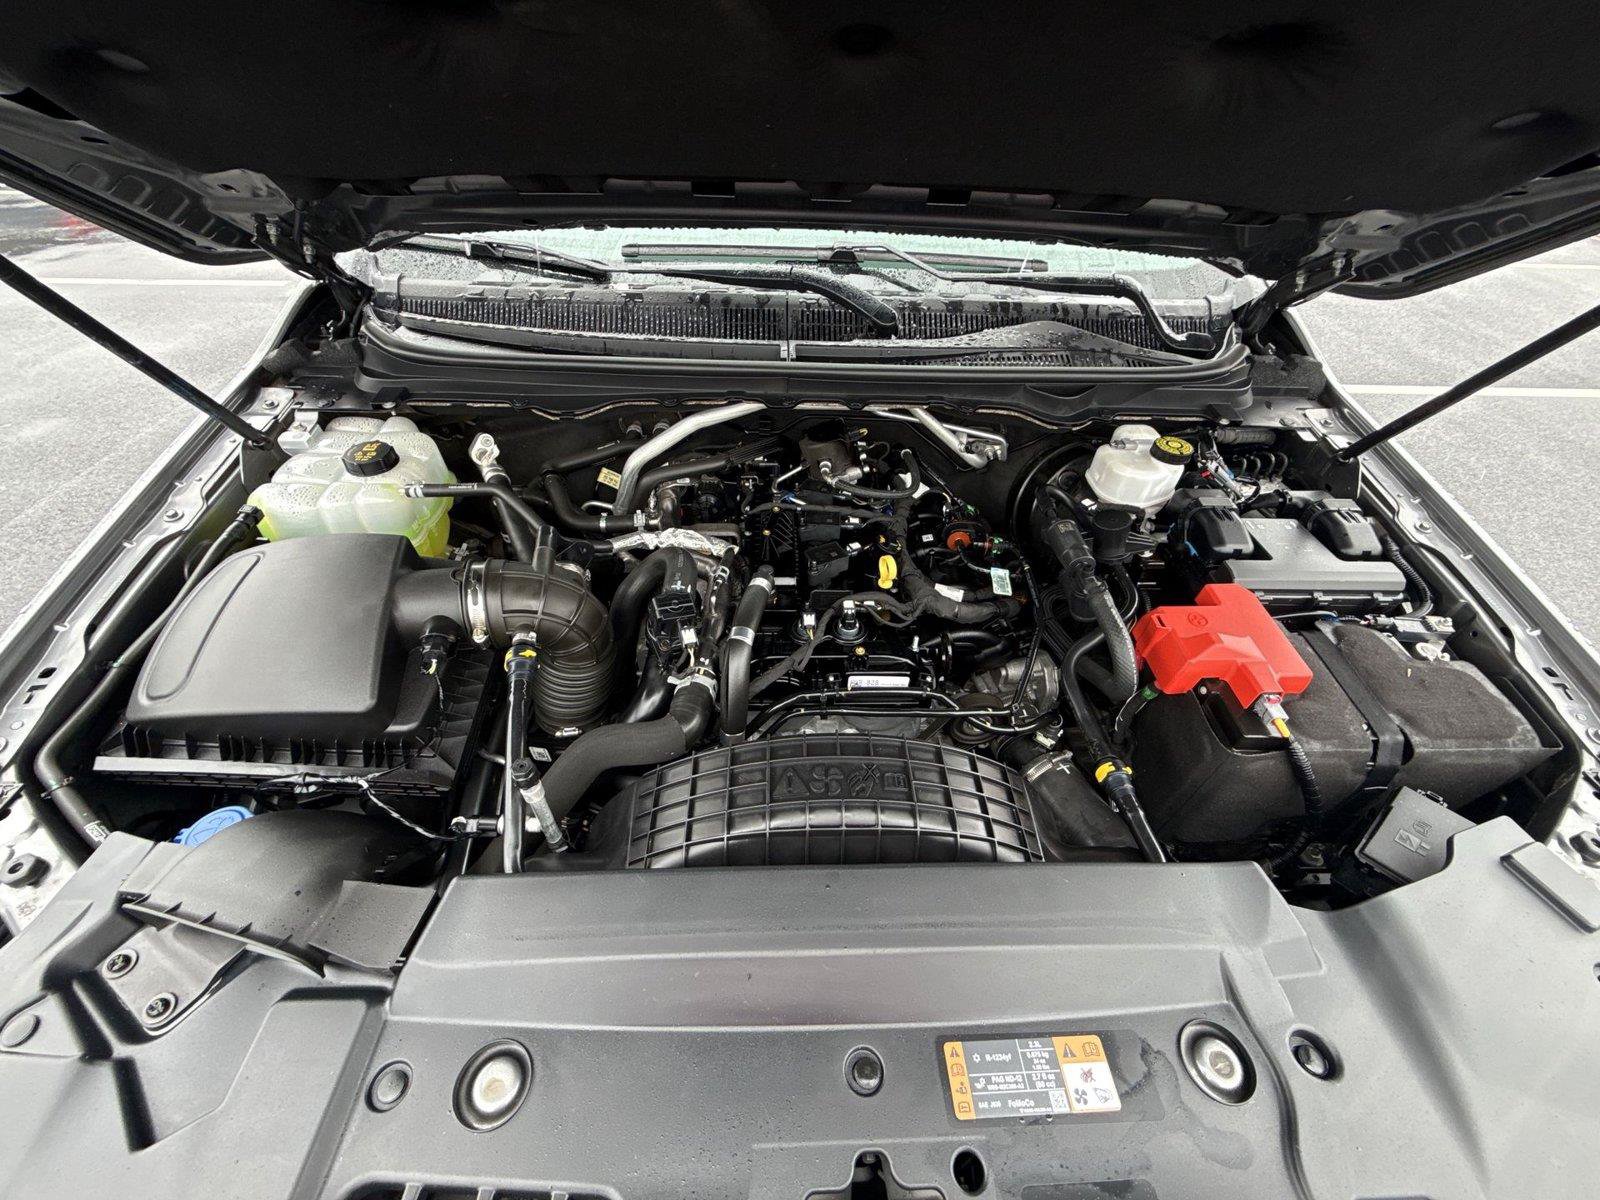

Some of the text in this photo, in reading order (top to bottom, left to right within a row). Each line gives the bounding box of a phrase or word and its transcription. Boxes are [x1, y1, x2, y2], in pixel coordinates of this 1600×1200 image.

[1041, 1051, 1050, 1059] kg
[991, 1075, 1004, 1083] PAG
[1008, 1099, 1035, 1108] FoMoCo
